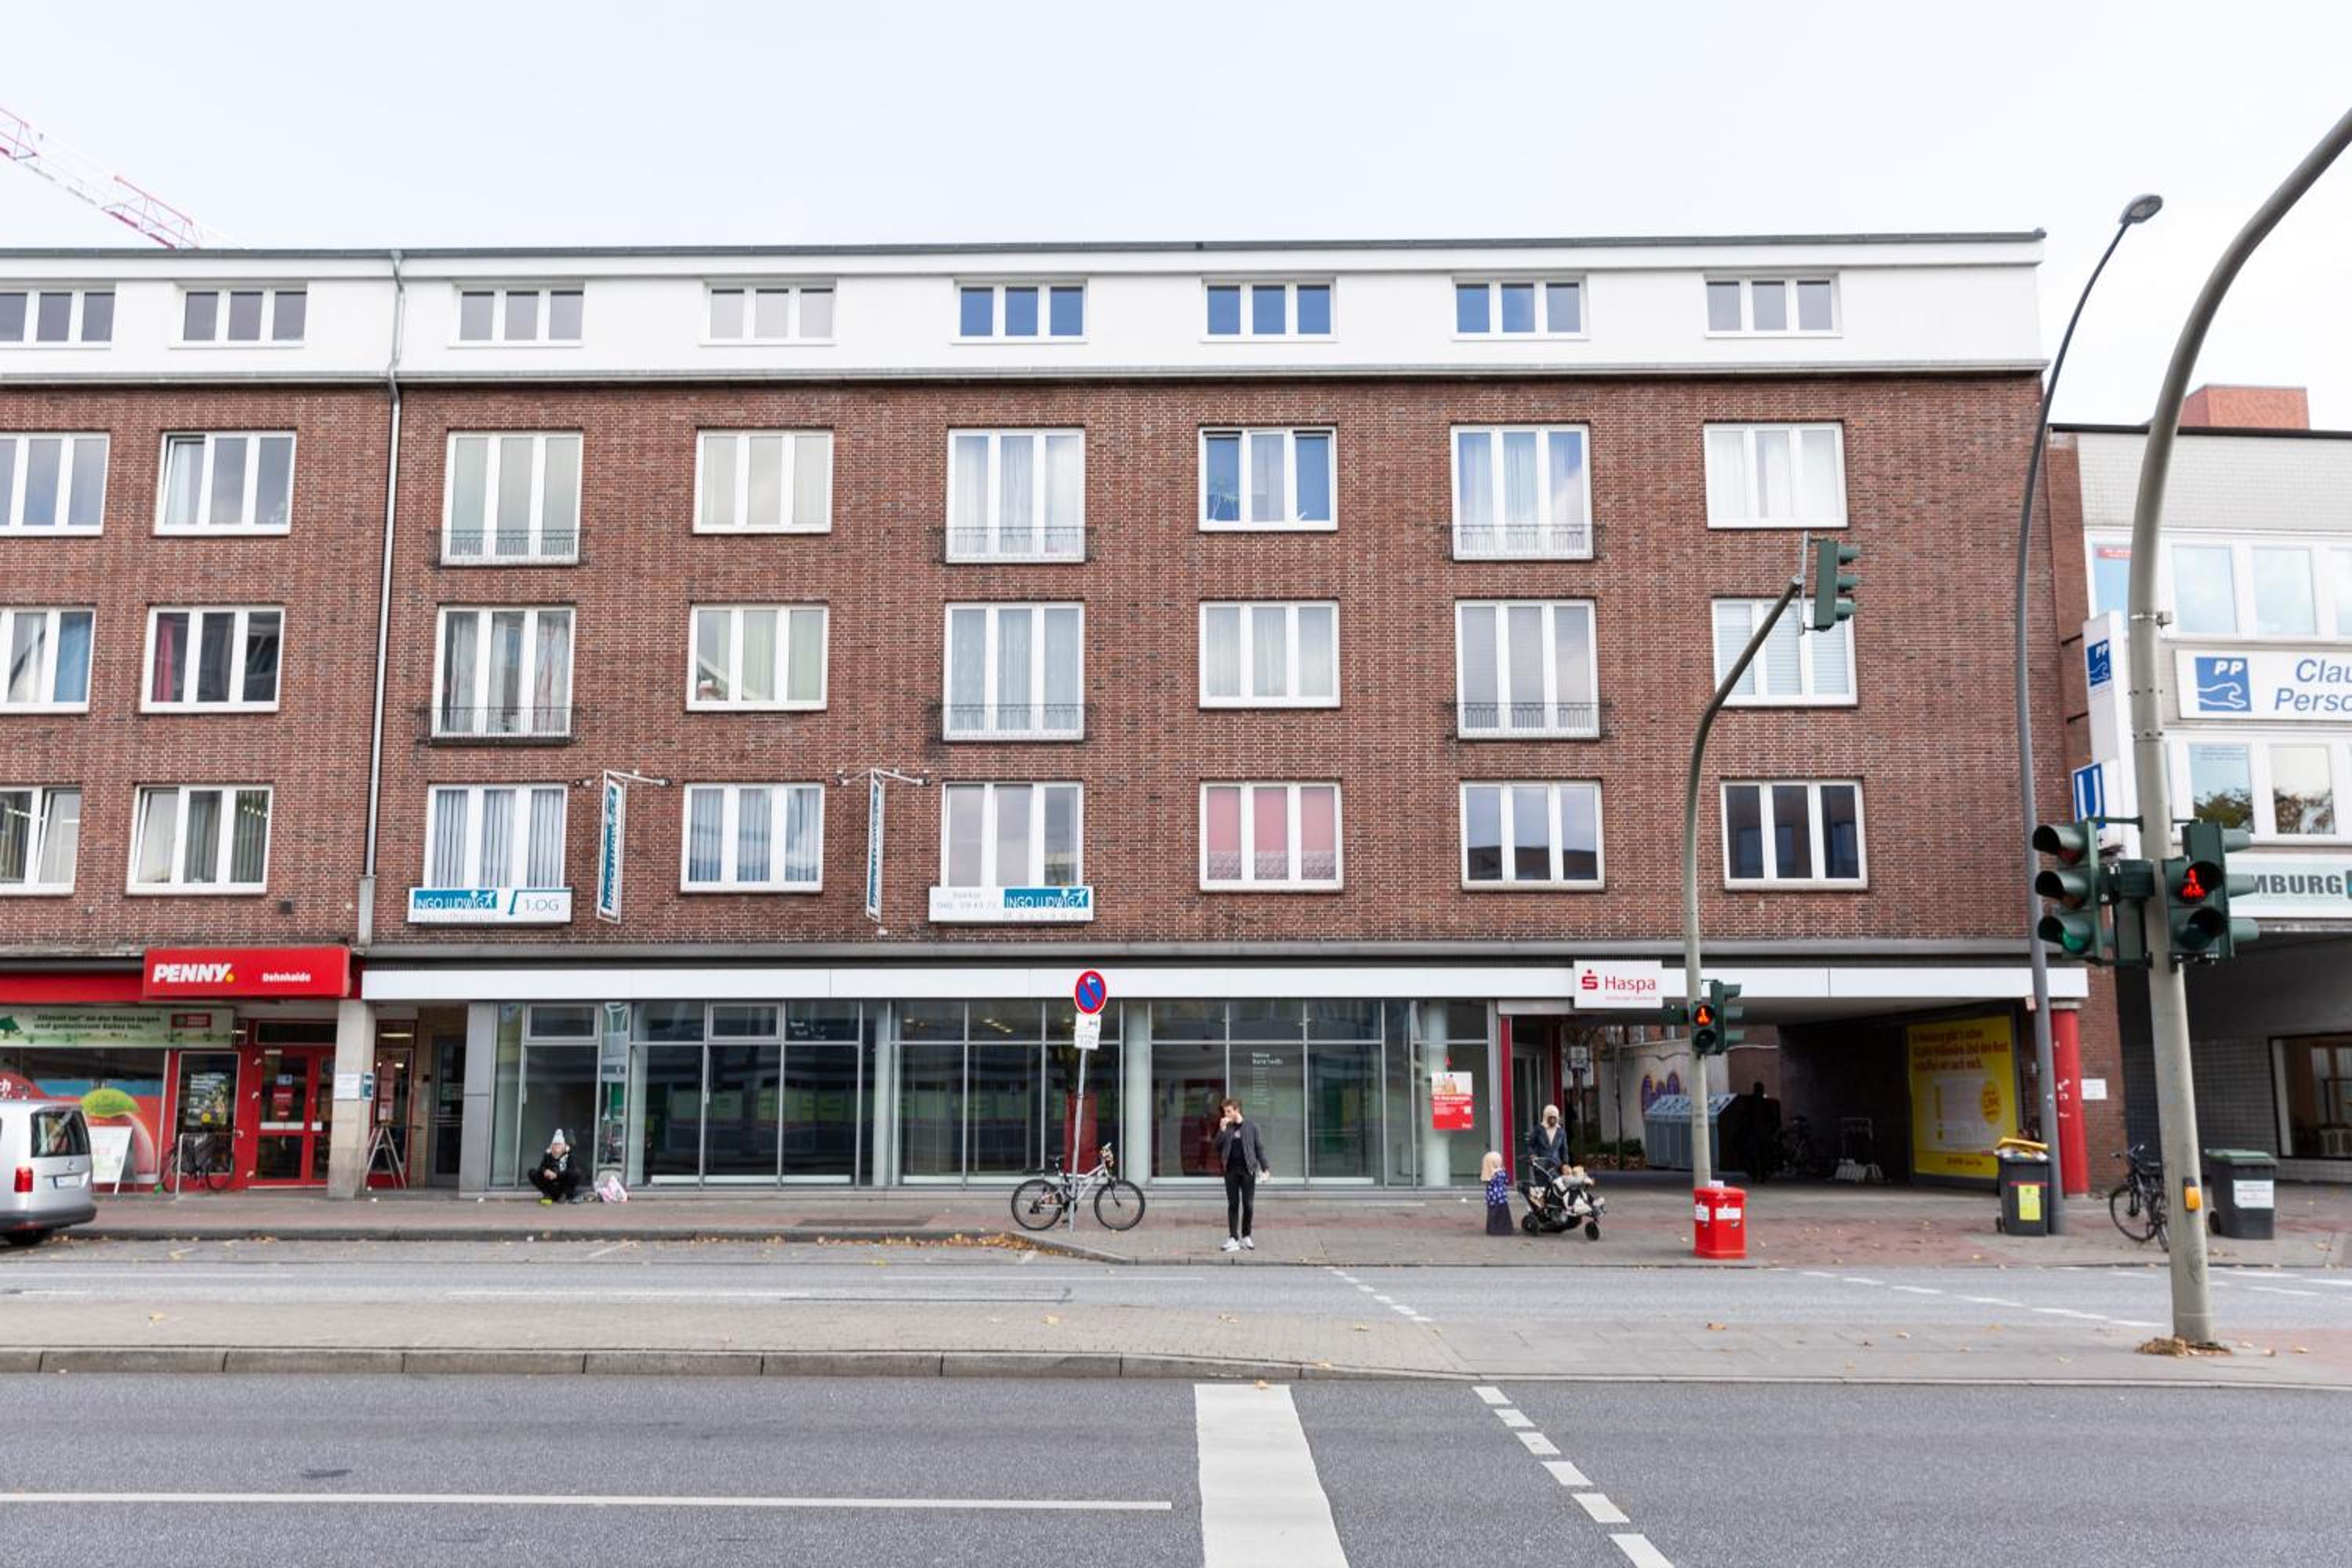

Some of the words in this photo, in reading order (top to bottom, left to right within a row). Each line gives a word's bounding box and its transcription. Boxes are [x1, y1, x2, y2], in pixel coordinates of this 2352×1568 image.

[2213, 660, 2245, 676] PP
[1006, 896, 1034, 909] INGO
[1605, 975, 1657, 994] Haspa
